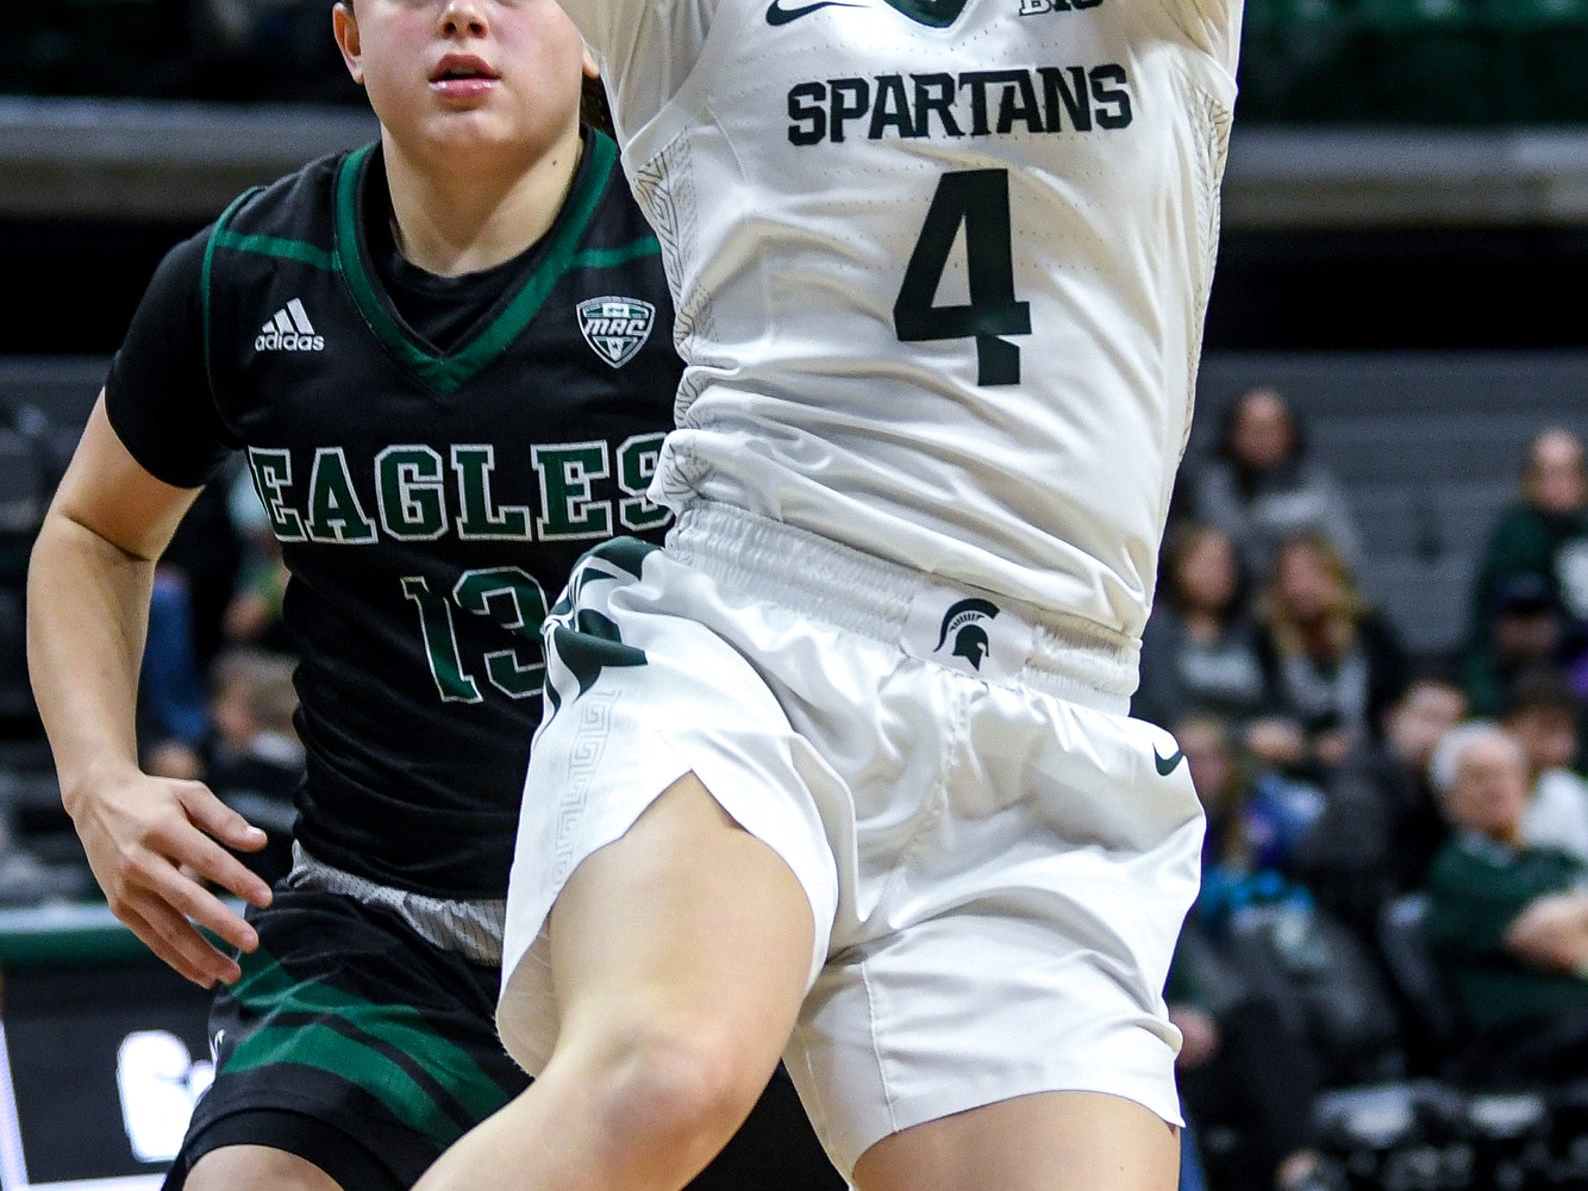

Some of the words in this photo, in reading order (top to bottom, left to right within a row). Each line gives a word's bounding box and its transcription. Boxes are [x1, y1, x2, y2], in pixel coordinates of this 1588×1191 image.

[787, 63, 1134, 146] SPARTANS
[892, 168, 1032, 387] 4
[254, 329, 325, 351] adidas
[248, 432, 676, 544] EAGLES
[400, 566, 548, 703] 13
